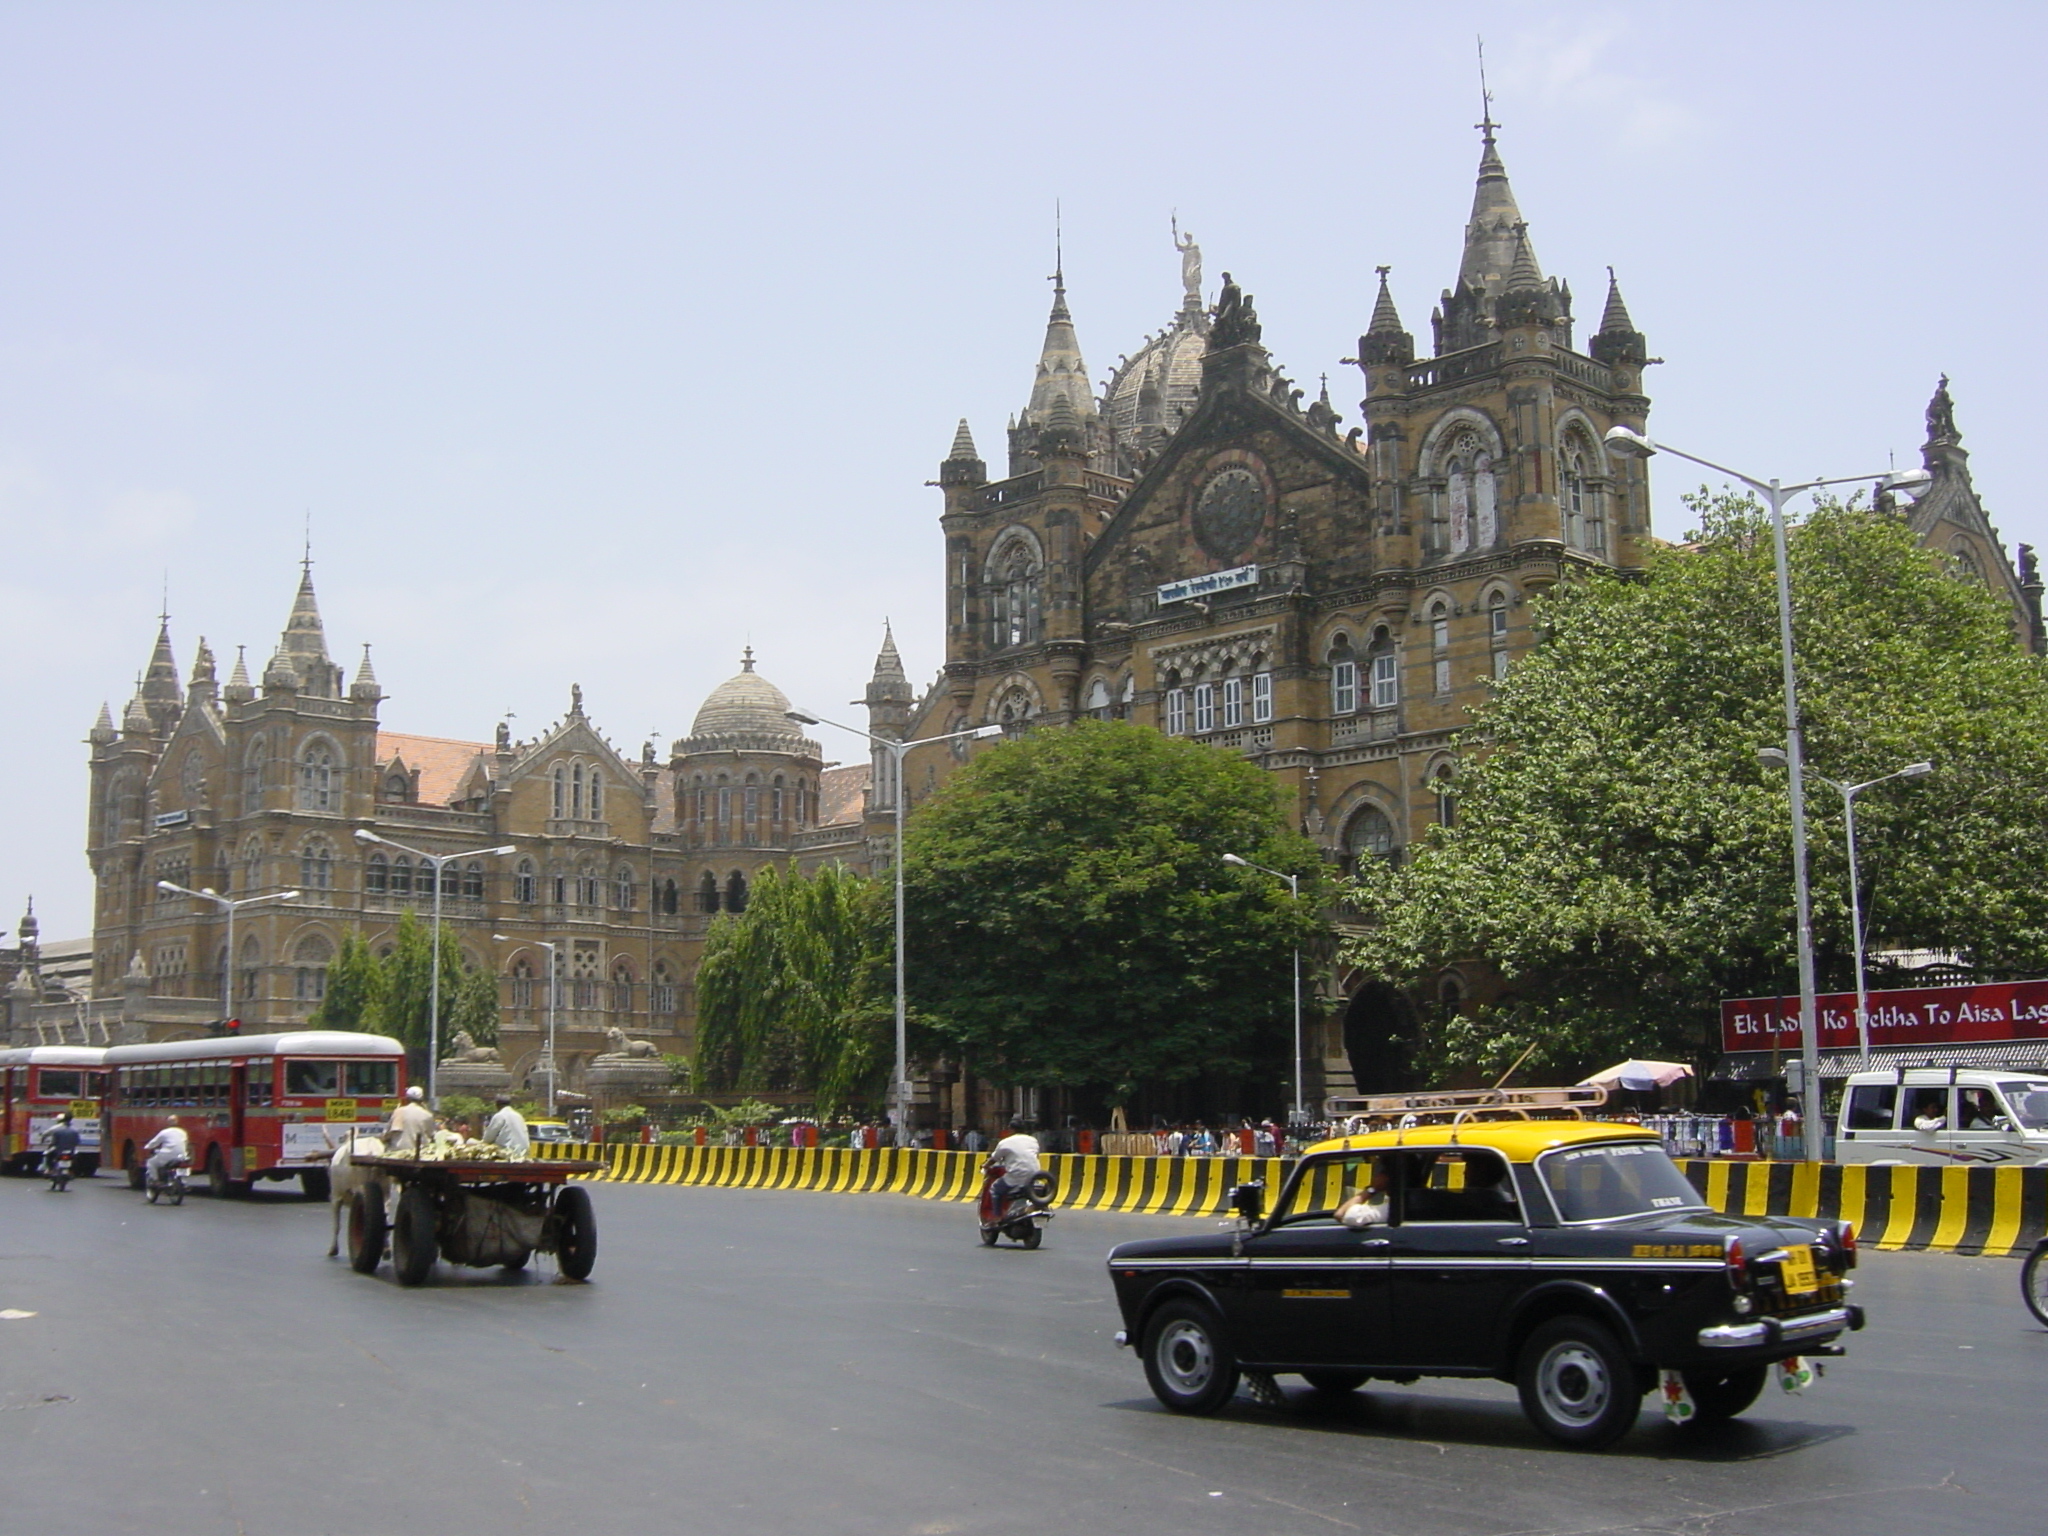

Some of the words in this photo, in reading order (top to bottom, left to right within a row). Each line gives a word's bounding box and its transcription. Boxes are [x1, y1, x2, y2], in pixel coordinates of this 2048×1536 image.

[1733, 1013, 1759, 1035] Ek
[1763, 1010, 1804, 1034] Lad
[1822, 1008, 1848, 1031] Ko
[1922, 1003, 1951, 1025] To
[1956, 1001, 2005, 1024] Aisa
